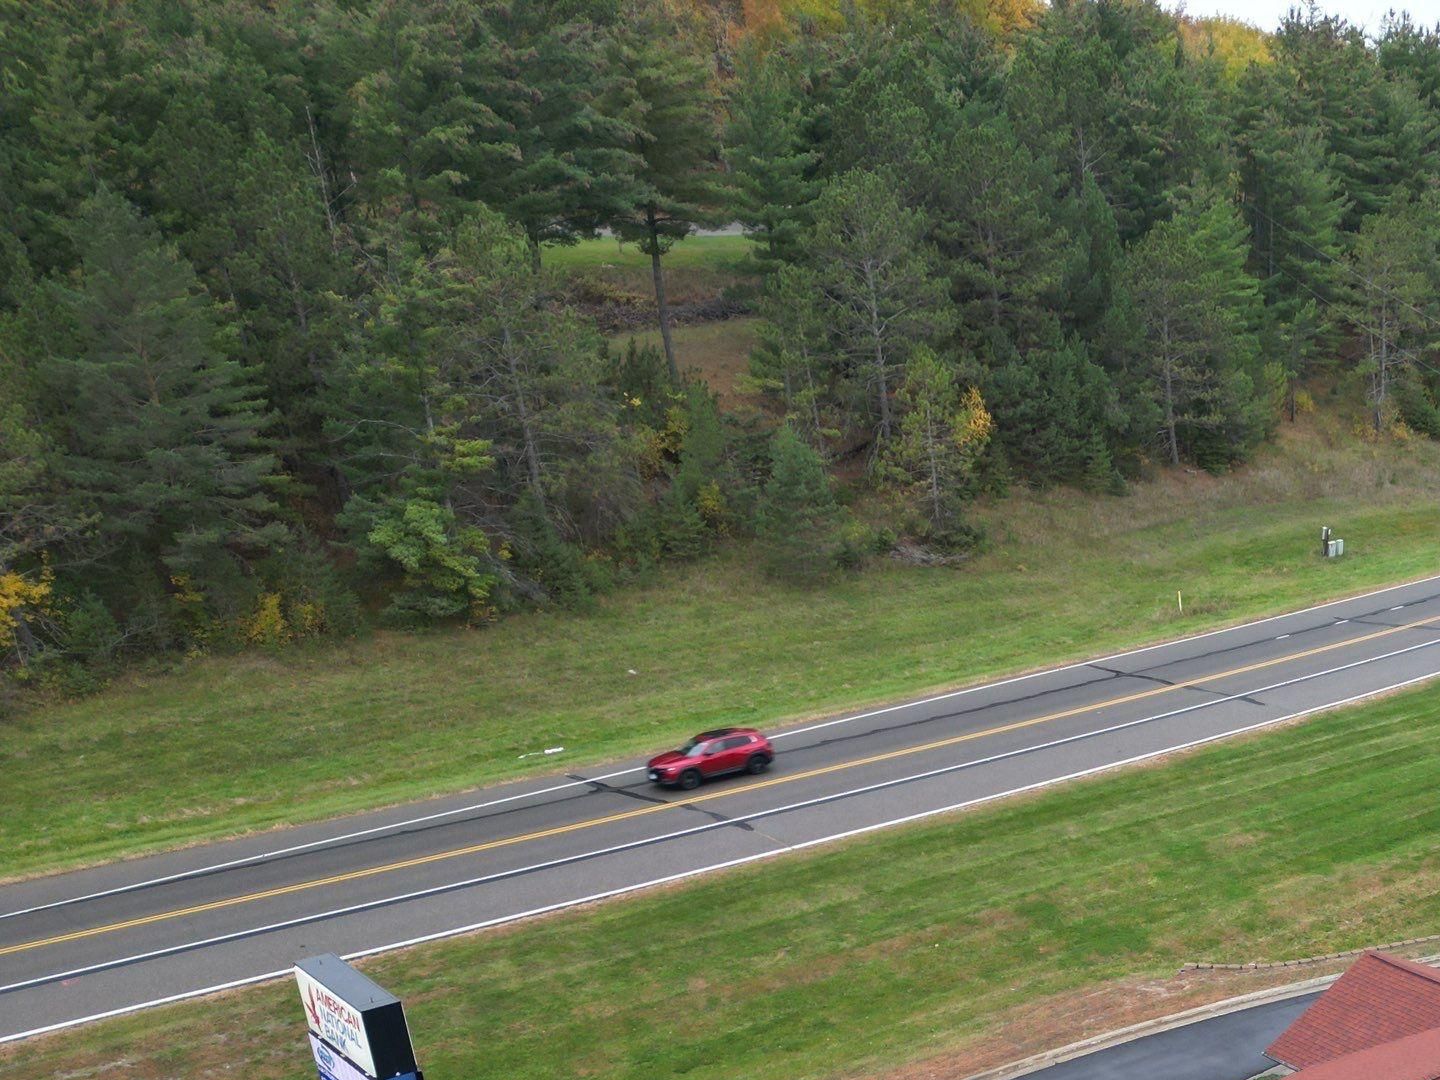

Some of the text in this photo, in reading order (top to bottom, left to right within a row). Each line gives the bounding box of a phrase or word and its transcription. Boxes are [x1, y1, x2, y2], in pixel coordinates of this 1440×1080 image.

[316, 988, 361, 1032] AMERICAN
[319, 1004, 362, 1049] NATIONAL
[324, 1024, 348, 1052] BANK
